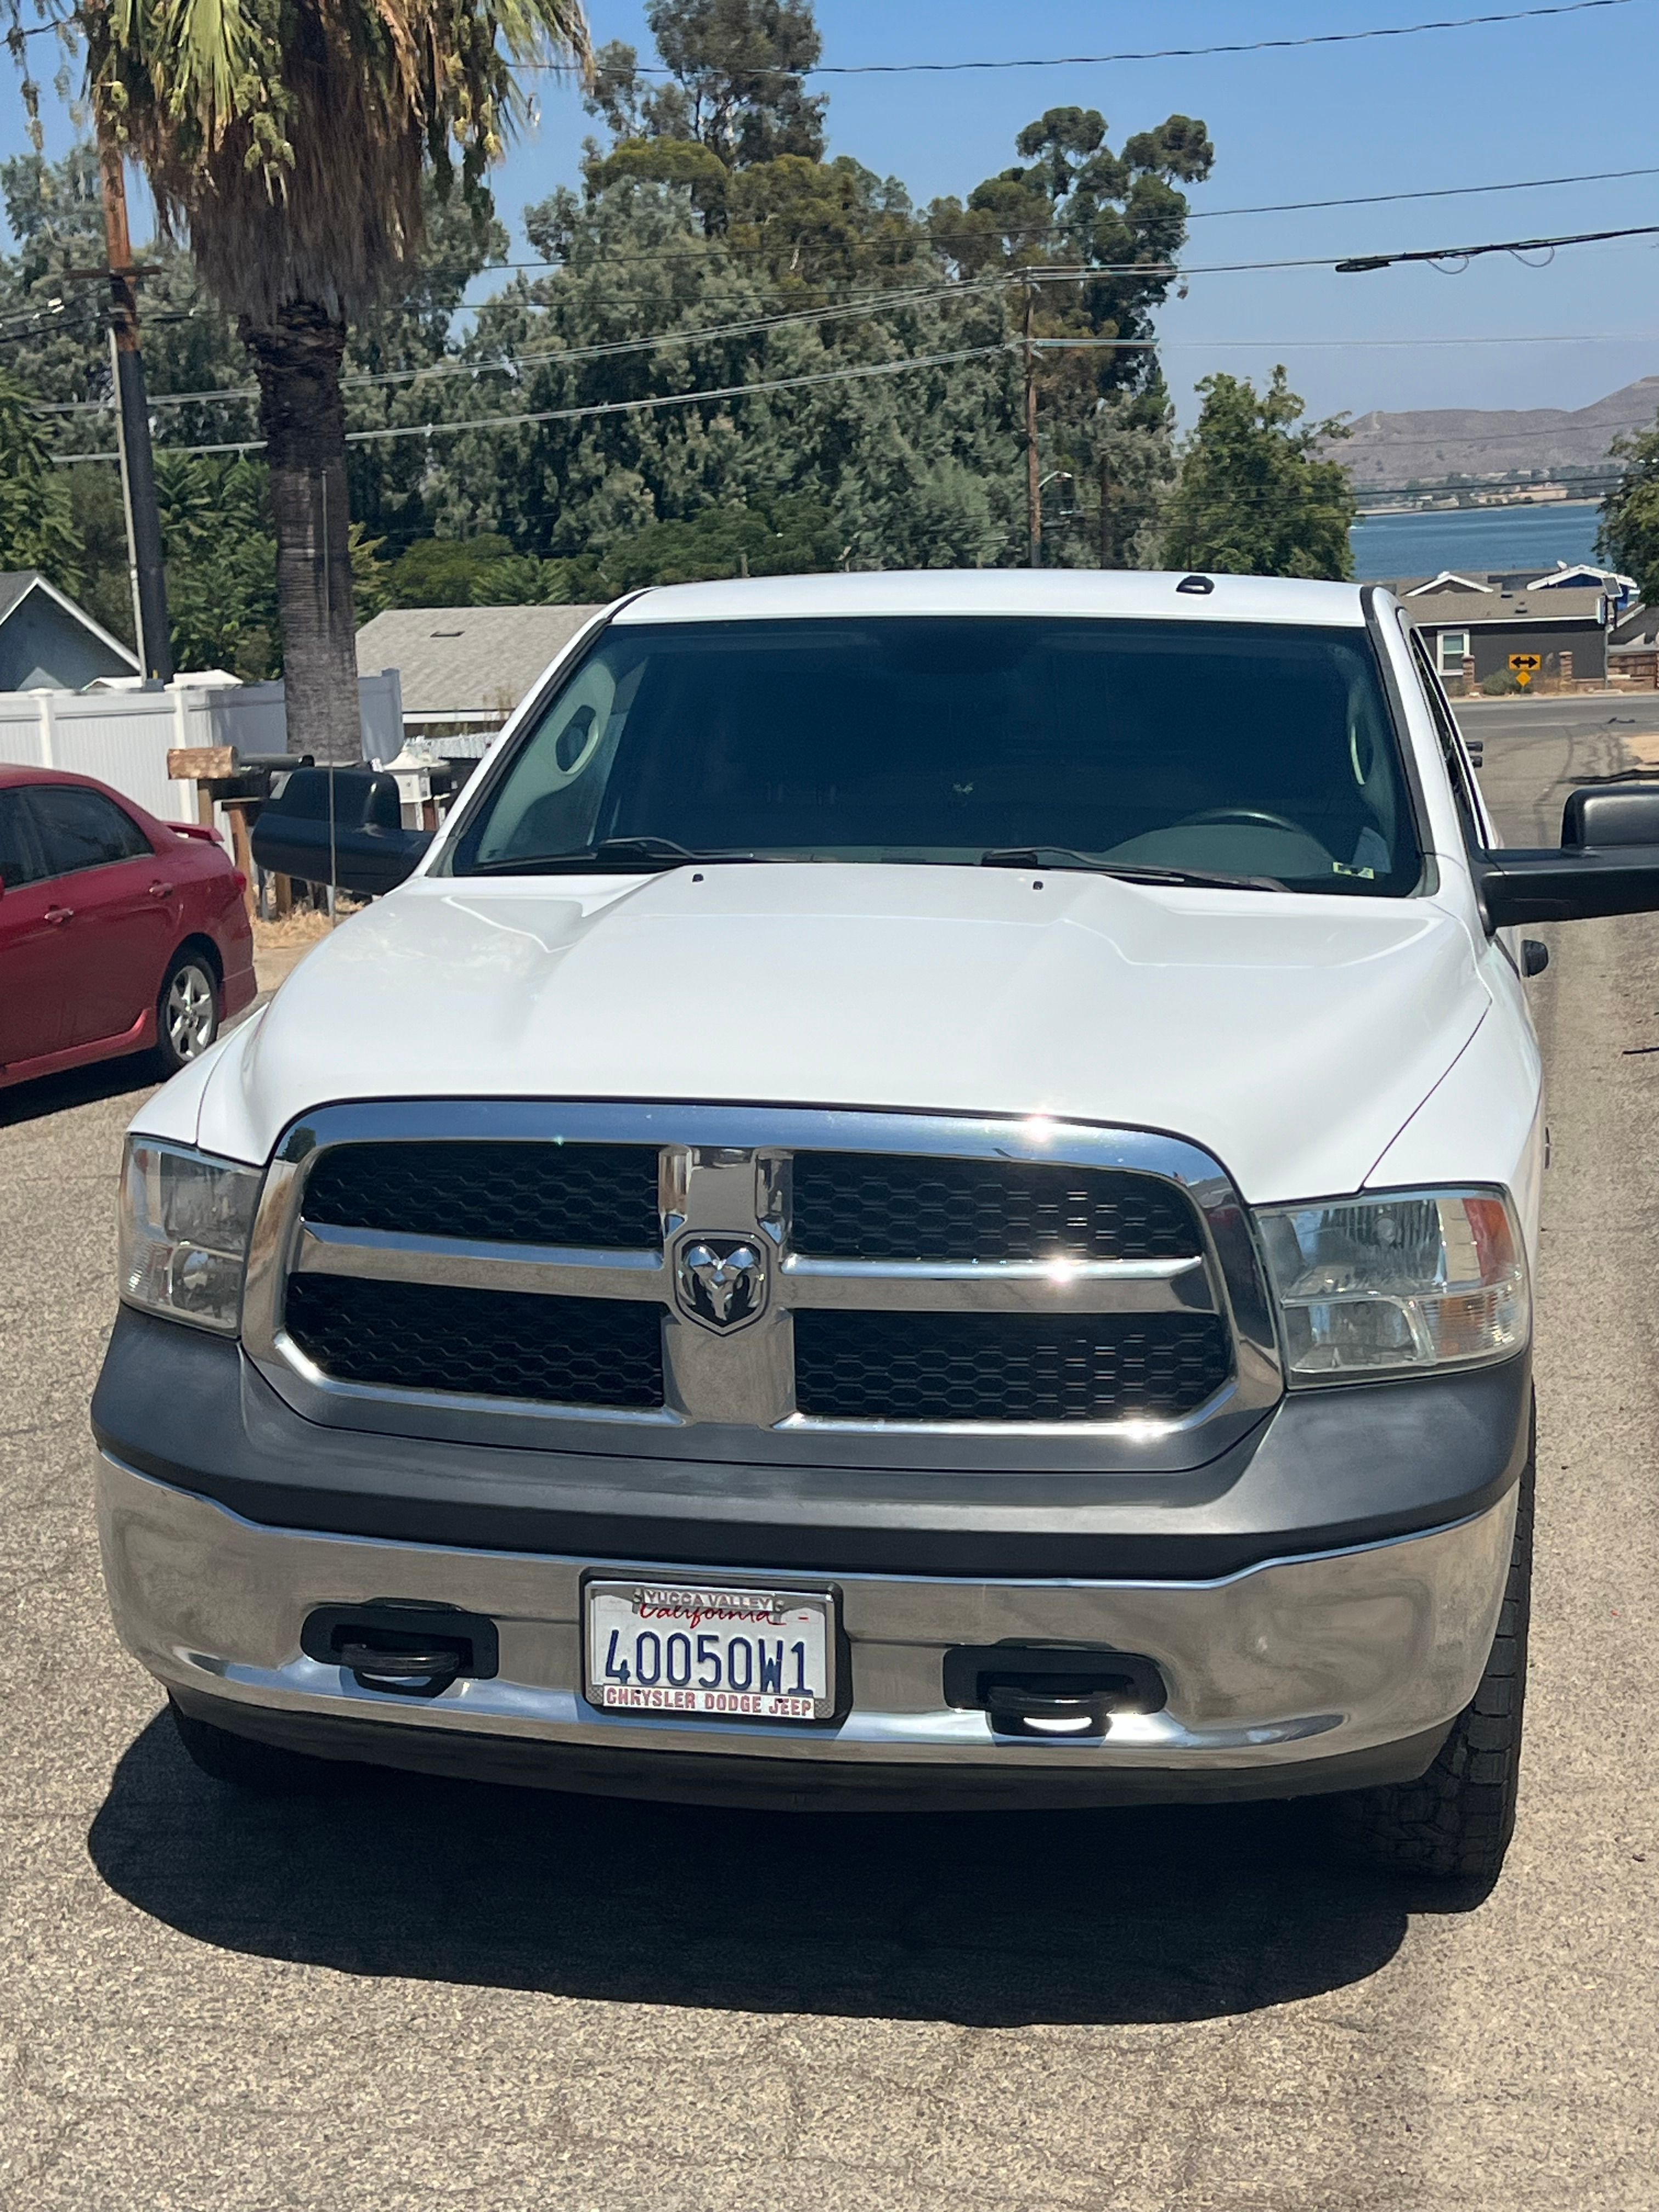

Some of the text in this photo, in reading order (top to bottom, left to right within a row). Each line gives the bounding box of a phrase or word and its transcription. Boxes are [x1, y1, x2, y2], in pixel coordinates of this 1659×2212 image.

[647, 1590, 770, 1611] YUCCA VALLEY
[640, 1603, 786, 1628] California
[606, 1630, 813, 1695] 40050W1
[606, 1687, 812, 1717] CHRYSLER DODGE JEEP
